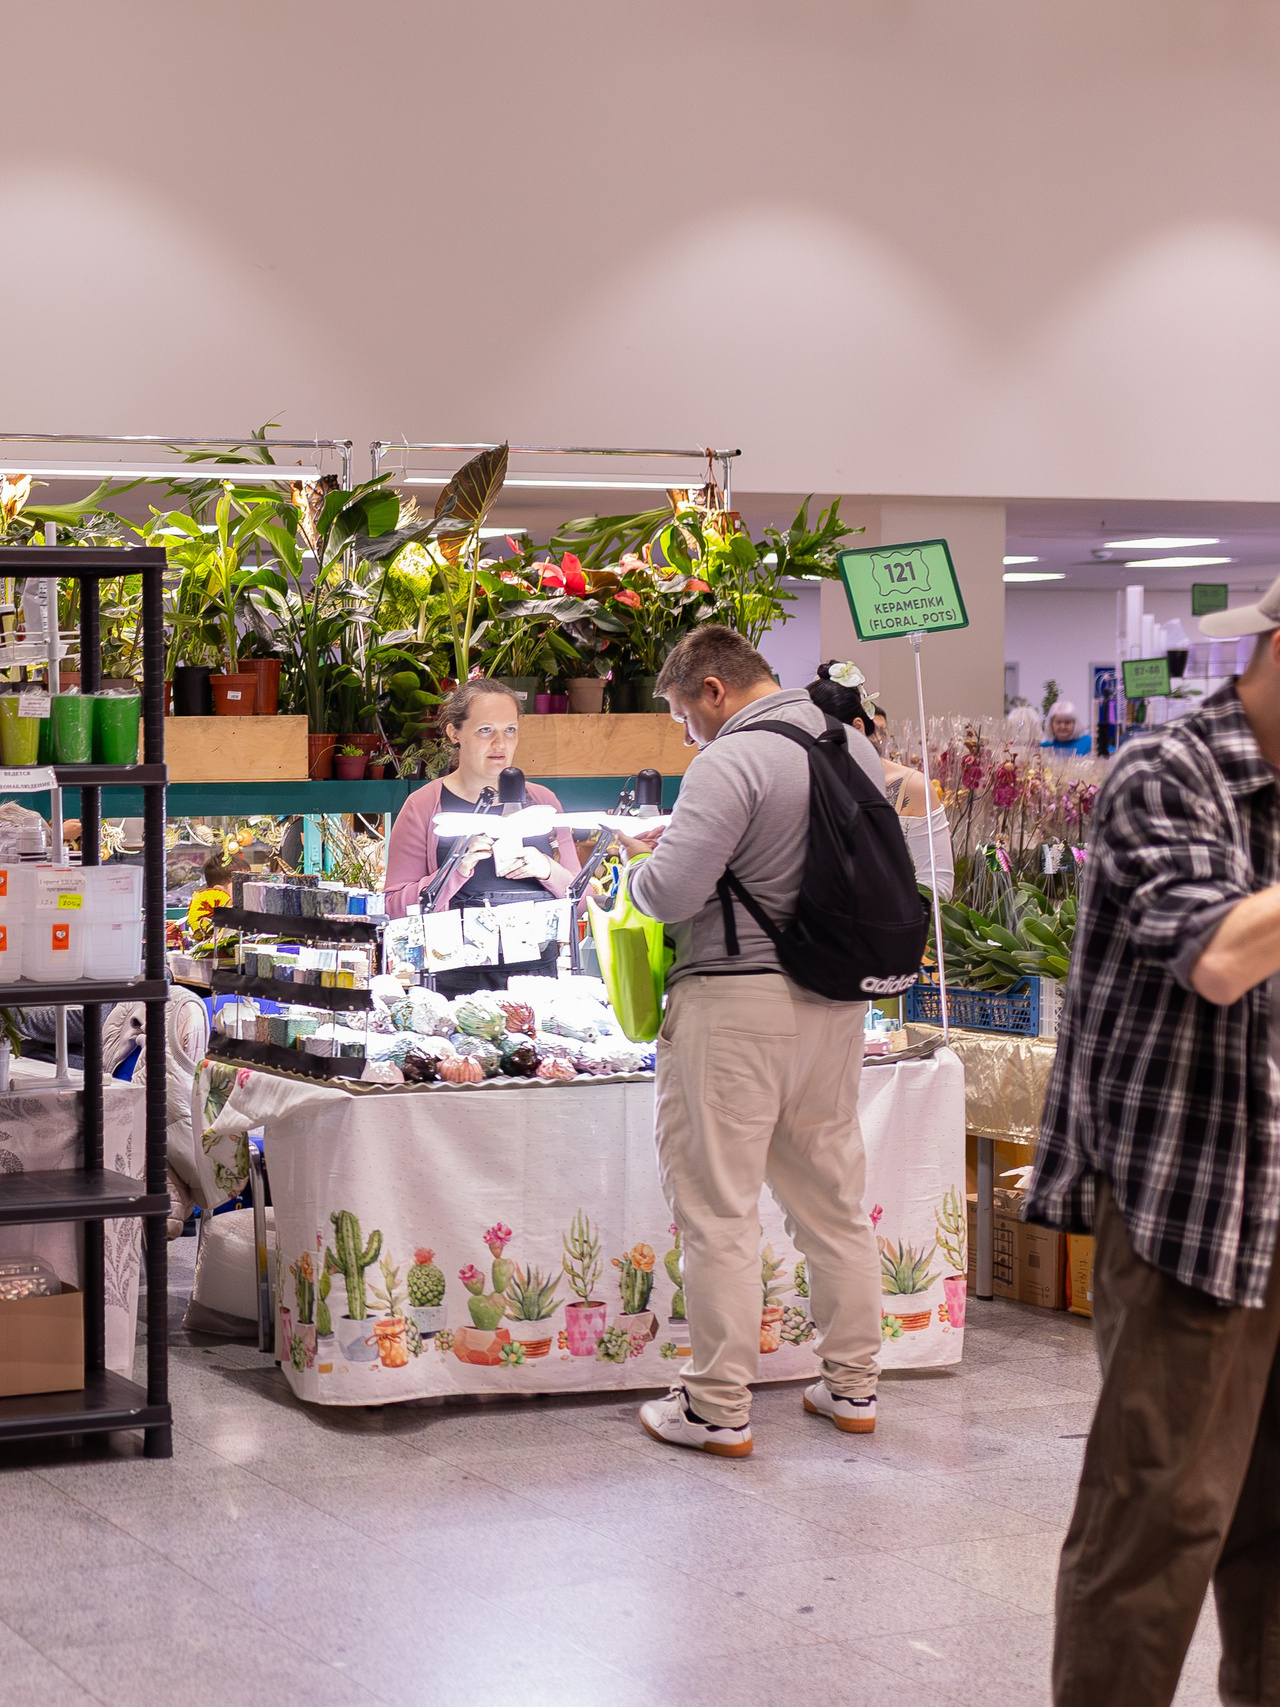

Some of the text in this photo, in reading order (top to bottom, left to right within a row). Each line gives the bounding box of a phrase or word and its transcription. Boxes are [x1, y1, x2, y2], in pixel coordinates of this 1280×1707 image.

[884, 561, 916, 583] 121
[874, 596, 945, 614] КЕРАМЕЛКИ
[869, 609, 957, 631] (FLORAL_POTS)
[860, 972, 919, 995] adidas
